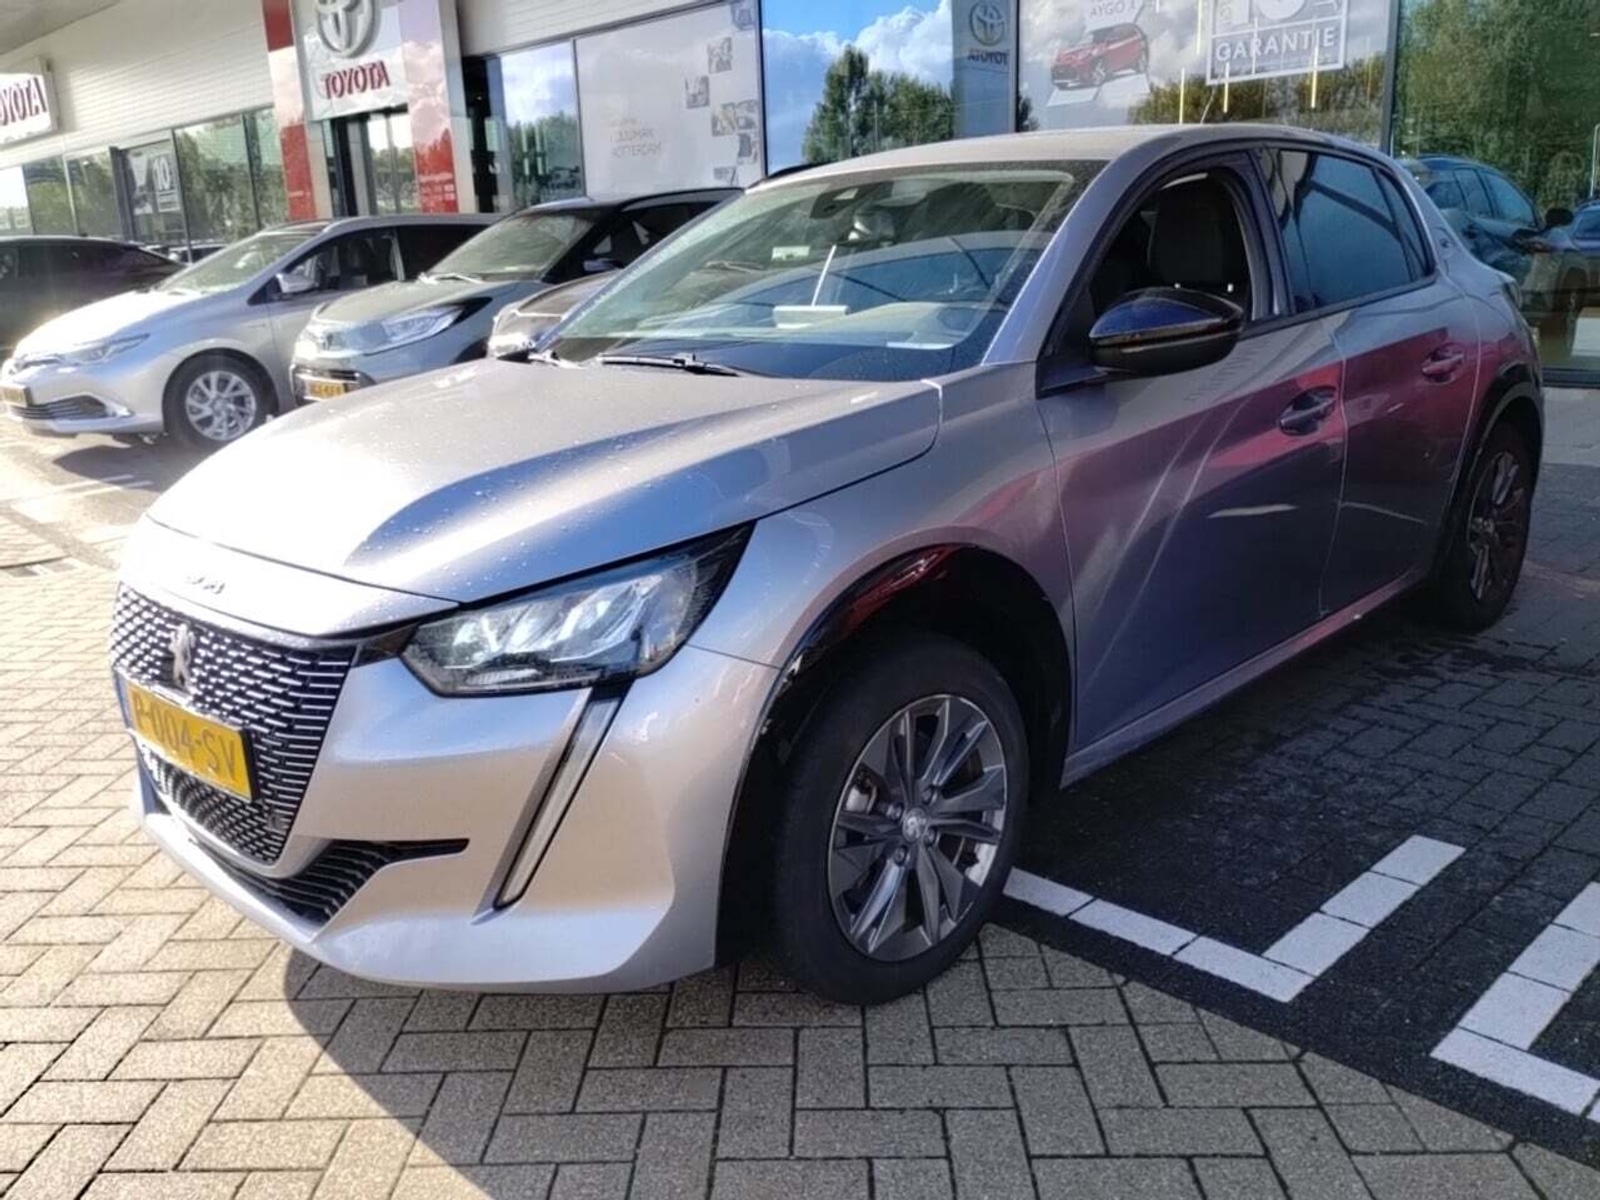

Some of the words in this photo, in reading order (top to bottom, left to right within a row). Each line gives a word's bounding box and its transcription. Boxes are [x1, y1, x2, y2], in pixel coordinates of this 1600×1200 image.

[1215, 27, 1336, 61] GARANTIE
[321, 61, 391, 99] TOYOTA
[0, 77, 47, 126] OYOTA
